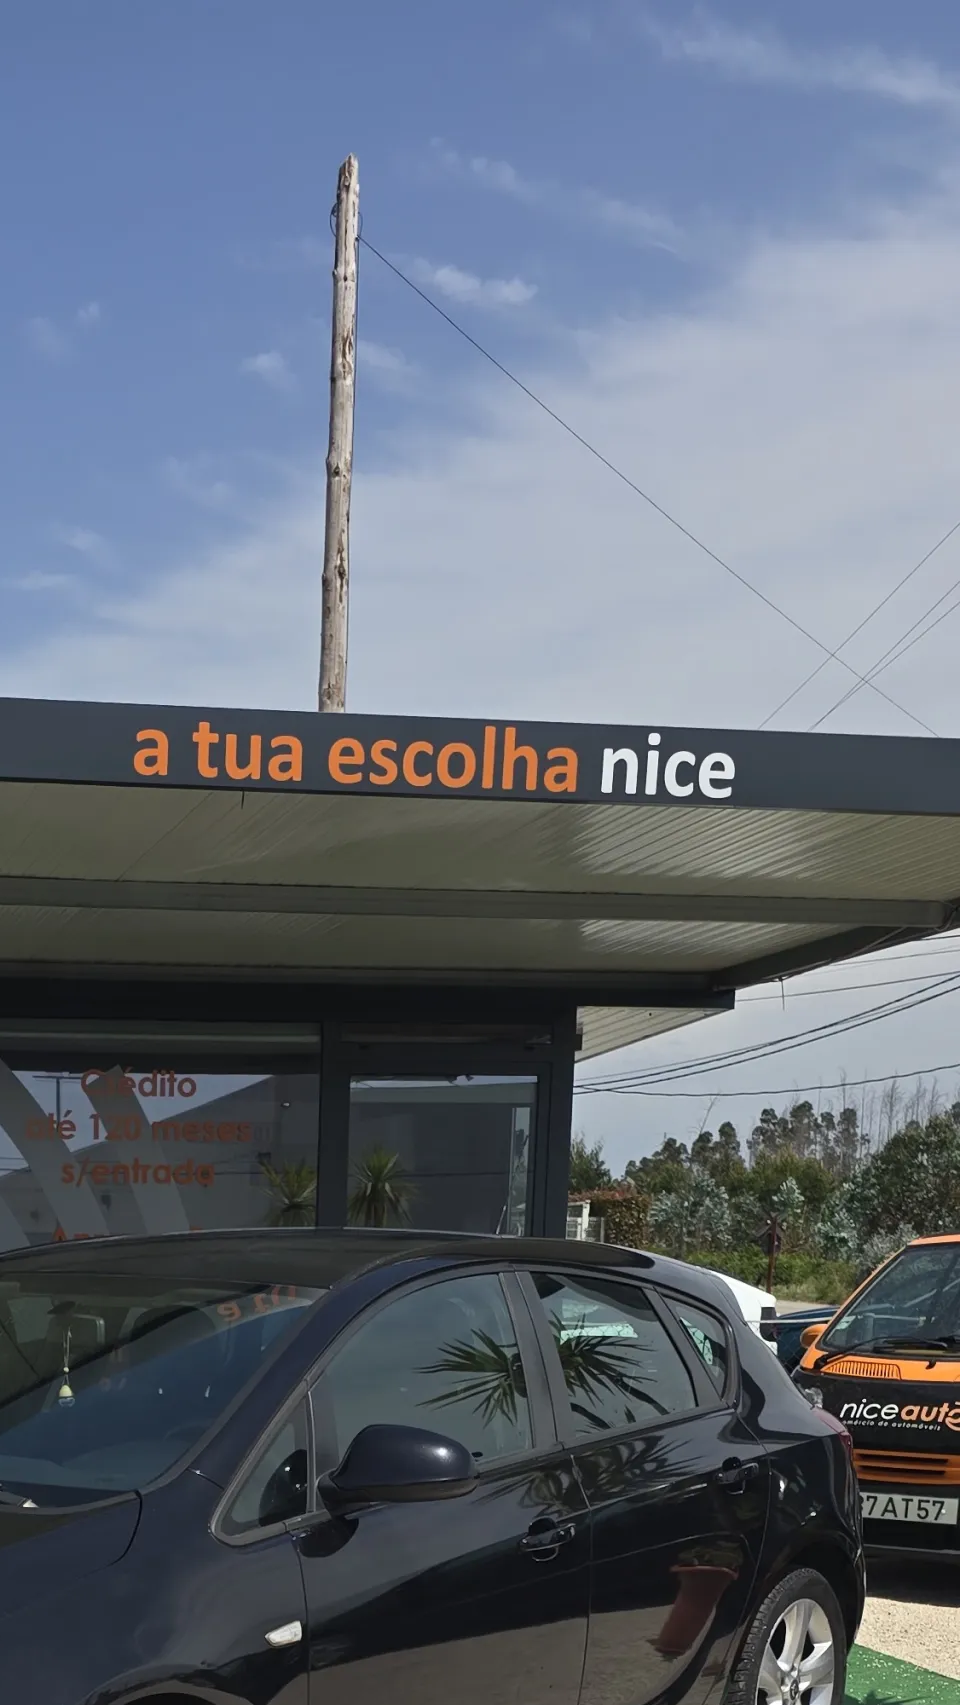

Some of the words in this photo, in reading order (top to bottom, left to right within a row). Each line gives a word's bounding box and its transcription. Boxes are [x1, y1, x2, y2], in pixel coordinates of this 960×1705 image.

[133, 728, 169, 777] a
[192, 721, 303, 783] tua
[328, 726, 579, 793] escolha
[600, 733, 737, 799] nice
[80, 1067, 197, 1098] Crédito
[25, 1109, 77, 1141] até
[89, 1113, 141, 1141] 120
[151, 1120, 252, 1143] meses
[60, 1158, 215, 1187] s/entrada
